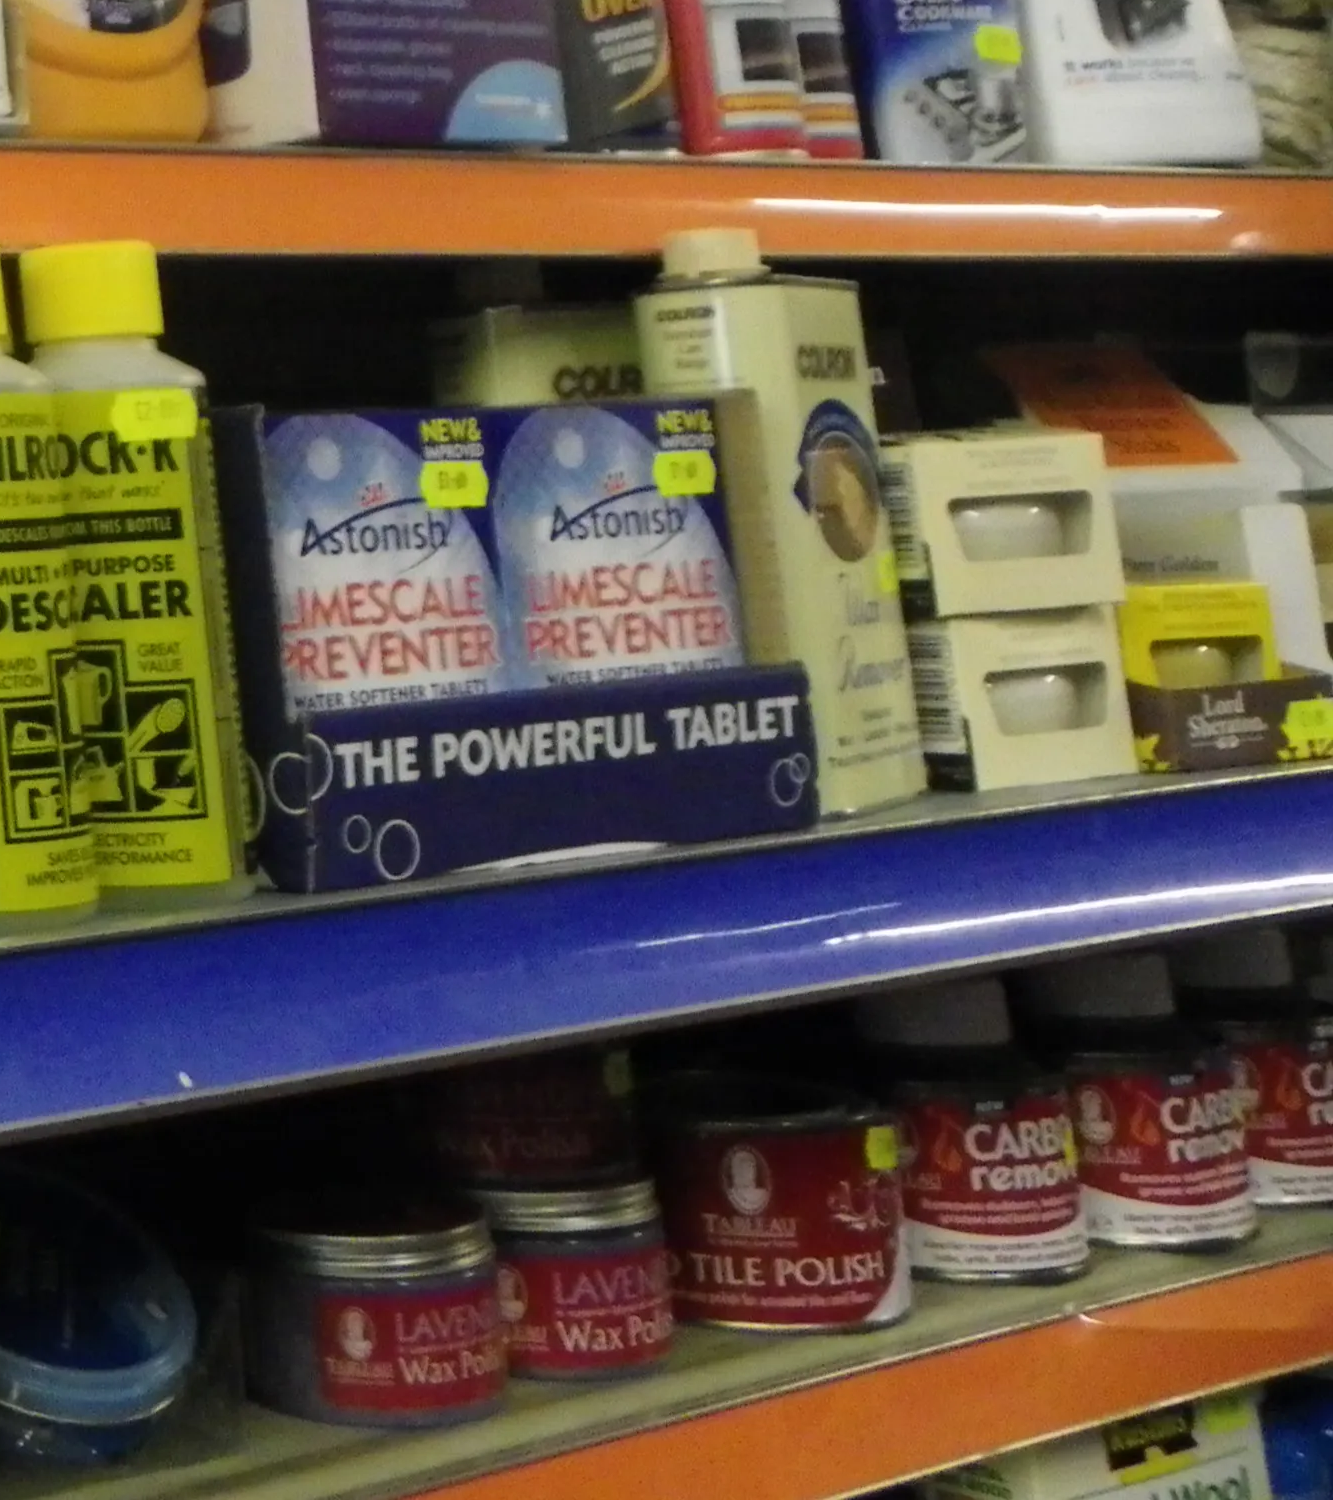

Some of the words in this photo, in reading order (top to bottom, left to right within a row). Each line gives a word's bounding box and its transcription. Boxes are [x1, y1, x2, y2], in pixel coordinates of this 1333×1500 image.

[299, 506, 452, 558] Astonish
[550, 498, 689, 545] Astonish
[283, 574, 486, 632] LIMESCALE
[529, 558, 718, 614] LIMESCALE
[283, 623, 499, 682] PREVENTER
[527, 606, 731, 660] PREVENTER
[294, 691, 345, 709] WATER
[350, 683, 426, 706] SOFTENER
[430, 678, 489, 698] TABLETS
[335, 734, 421, 789] THE
[433, 712, 655, 780] POWERFUL
[666, 695, 801, 751] TABLET
[964, 1113, 1073, 1162] CARB
[690, 1251, 766, 1286] TILE
[774, 1250, 886, 1287] POLISH
[394, 1302, 494, 1343] LAVEN
[557, 1319, 624, 1354] Wax
[398, 1354, 456, 1386] Wax
